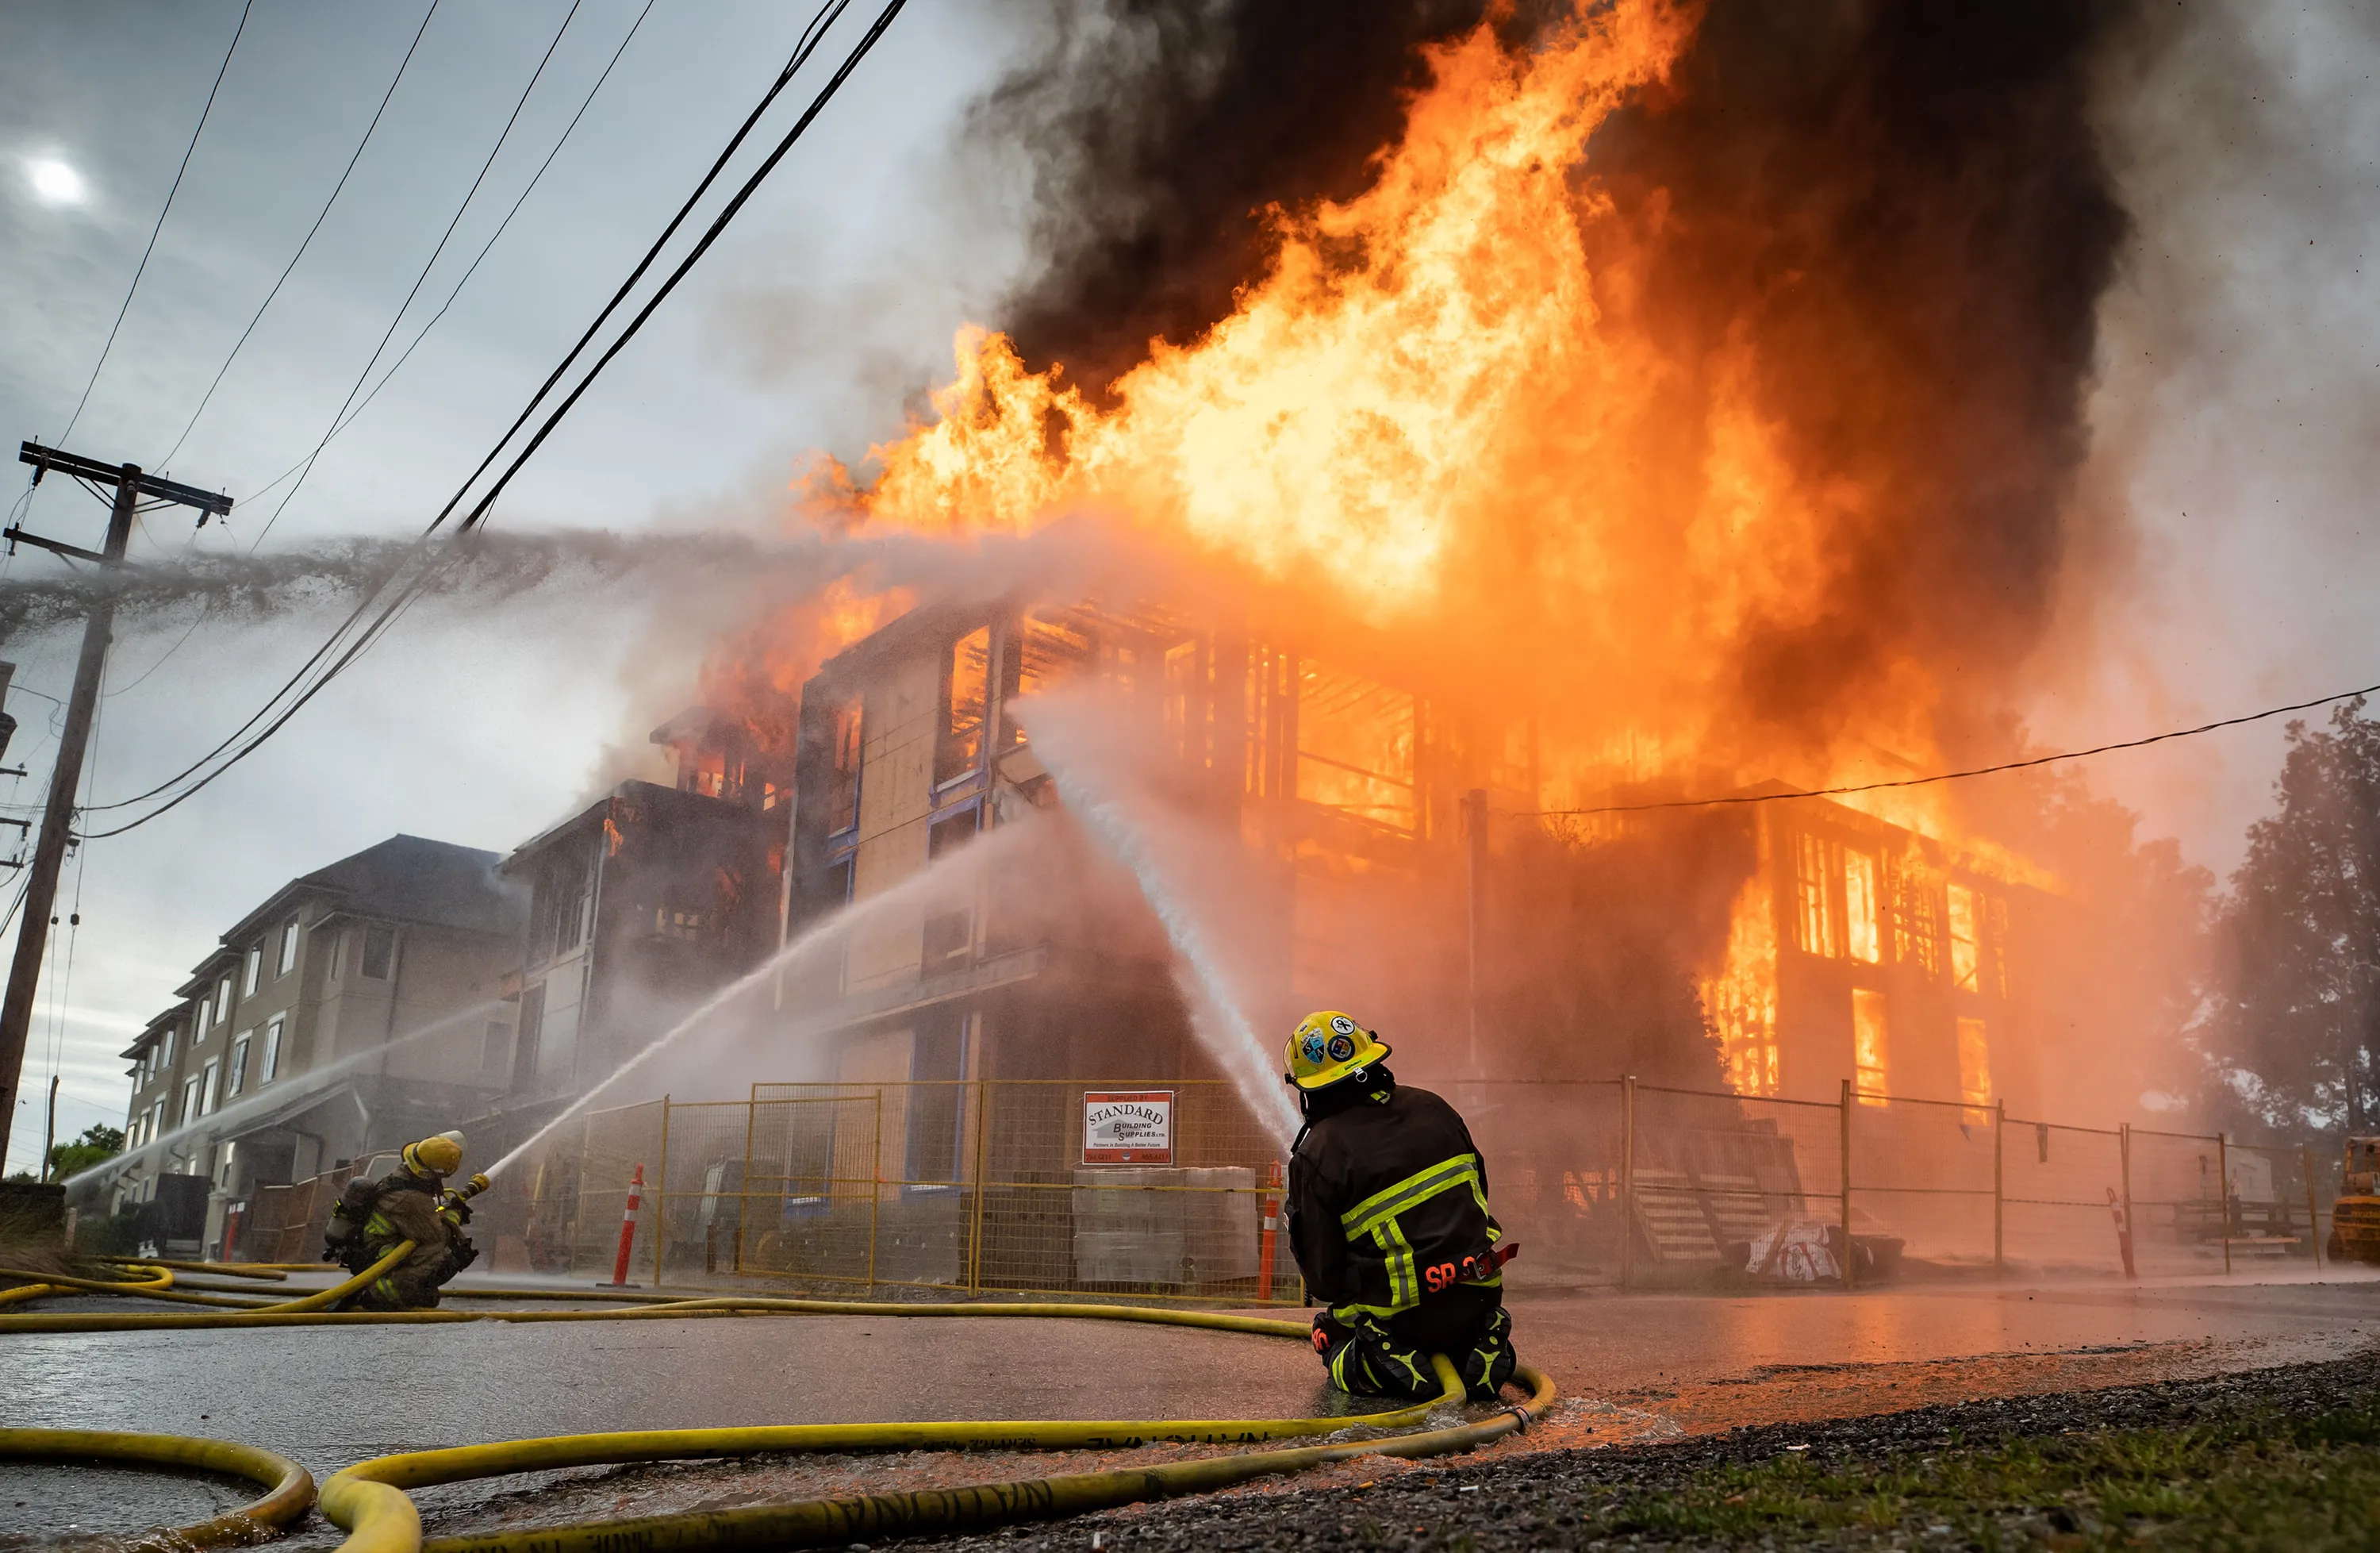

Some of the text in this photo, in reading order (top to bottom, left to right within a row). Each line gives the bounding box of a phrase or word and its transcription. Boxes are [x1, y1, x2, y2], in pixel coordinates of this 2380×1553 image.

[1088, 1104, 1163, 1126] STANDARD
[1113, 1123, 1152, 1133] BUILDING
[1118, 1131, 1156, 1141] SUPPLIES
